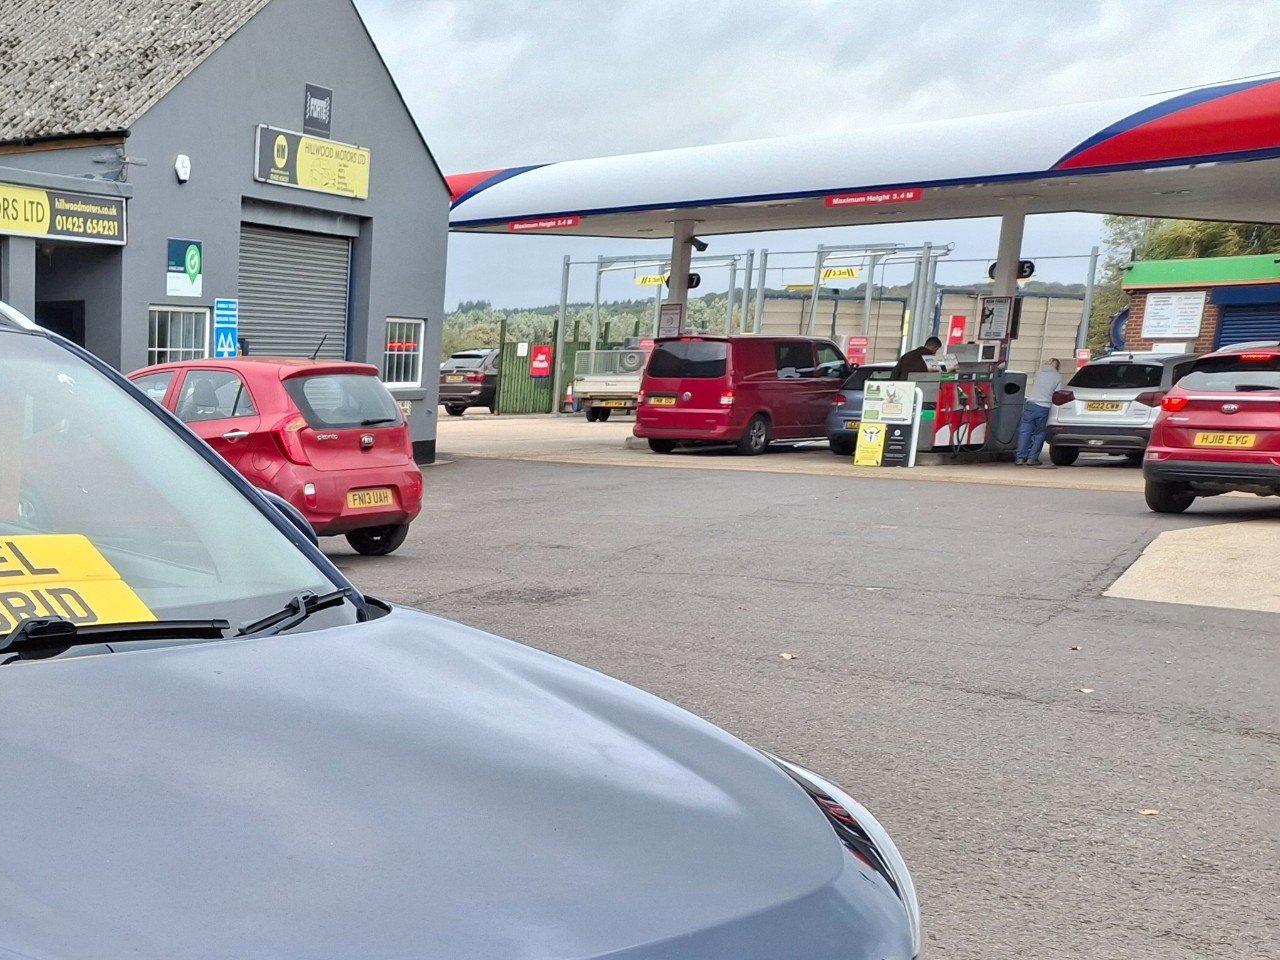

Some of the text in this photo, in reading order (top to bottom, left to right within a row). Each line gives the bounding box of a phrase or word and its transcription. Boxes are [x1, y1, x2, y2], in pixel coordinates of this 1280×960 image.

[304, 142, 334, 159] HILLWOOD
[335, 149, 357, 164] MOTORS
[55, 198, 118, 216] hillwoodmotors.co.uk
[832, 196, 866, 204] Maximum
[24, 200, 45, 223] LTD
[55, 214, 119, 236] 01425 654231
[1022, 263, 1031, 276] 5
[692, 275, 699, 286] 7
[951, 327, 963, 337] Air
[1201, 434, 1249, 445] HJ18 EYG
[352, 491, 389, 506] FN13 UAH
